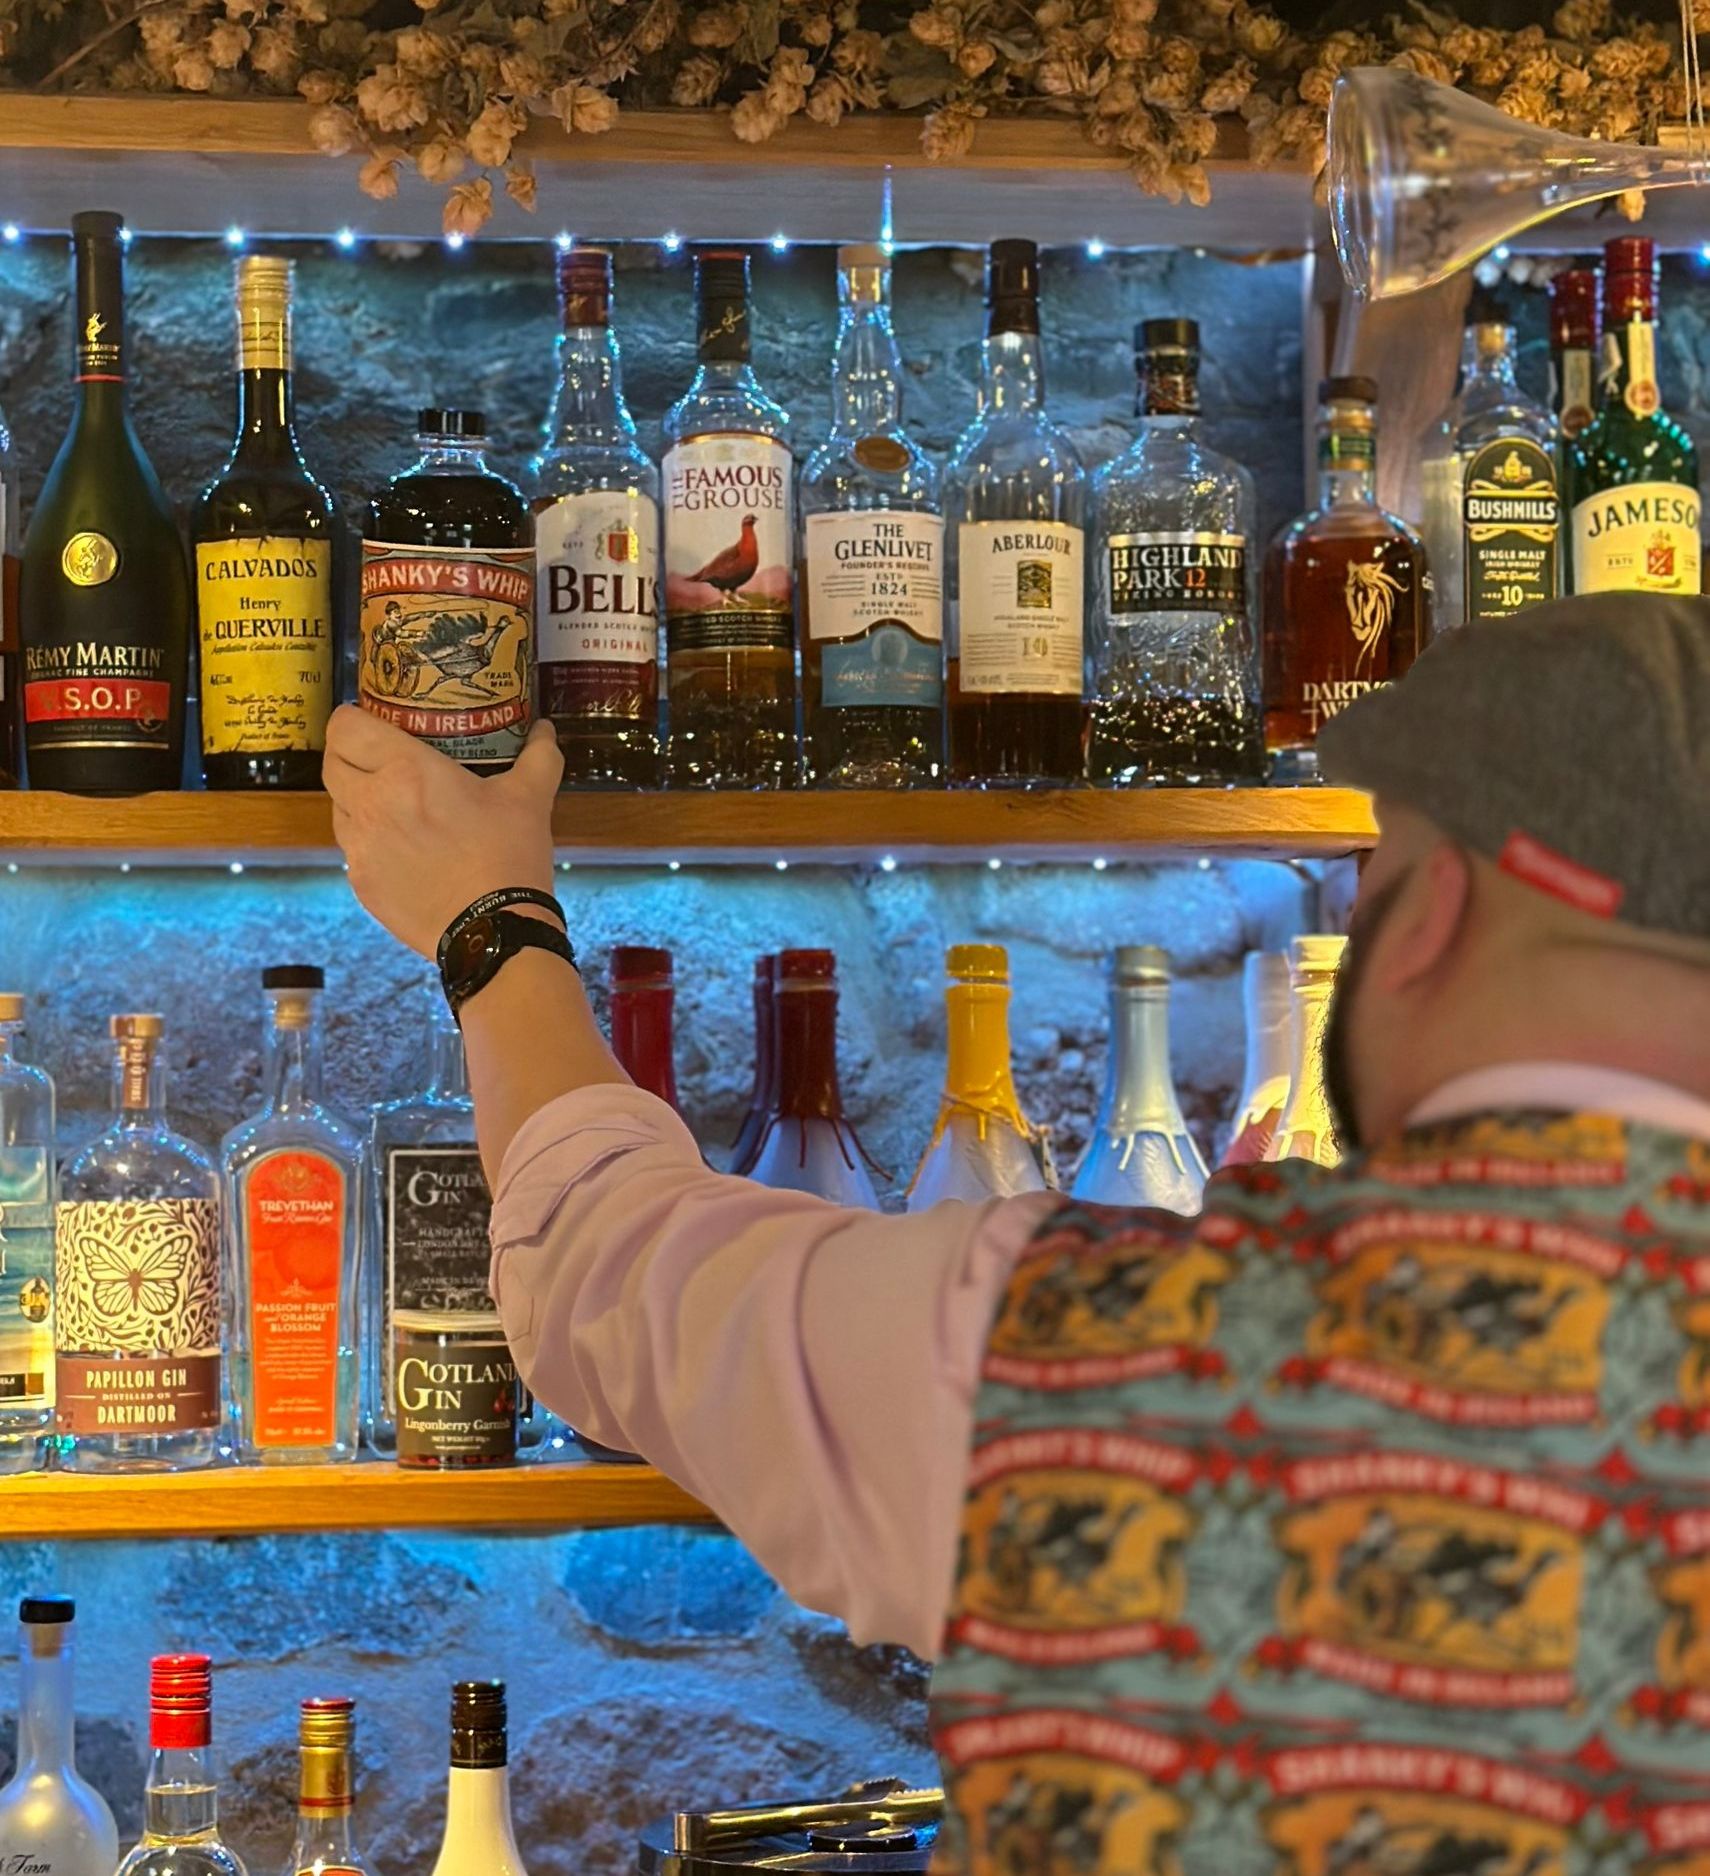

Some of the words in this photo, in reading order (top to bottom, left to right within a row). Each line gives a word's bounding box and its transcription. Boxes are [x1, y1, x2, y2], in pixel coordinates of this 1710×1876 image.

[685, 465, 783, 490] FAMOUS
[684, 487, 784, 511] GROUSE
[1468, 499, 1556, 520] BUSHMILLS
[1588, 498, 1697, 538] JAMESO
[873, 524, 904, 538] THE
[835, 540, 933, 561] GLENLIVET
[992, 534, 1071, 556] ABERLOUR
[1479, 550, 1516, 560] SINGLE
[1518, 550, 1546, 560] MALT
[841, 561, 893, 570] FOUNDER'S
[1113, 546, 1241, 569] HIGHLAND
[205, 558, 319, 581] CALVADOS
[1113, 568, 1182, 592] PARK
[1186, 567, 1206, 588] 12
[362, 564, 469, 594] SHANKY'S
[477, 568, 530, 599] WHIP
[871, 582, 908, 596] 1824
[240, 597, 281, 612] Henry
[1501, 585, 1524, 606] 10
[215, 618, 326, 640] QUERVILLE
[558, 622, 599, 630] BLENDED
[582, 638, 648, 652] ORIGINAL
[26, 644, 71, 670] RÉMY
[77, 642, 160, 668] MARTIN
[66, 668, 89, 676] FINE
[93, 668, 155, 677] CHAMPAGNE
[1304, 681, 1393, 701] DARTM
[364, 699, 401, 722] ADE
[408, 714, 427, 731] IN
[435, 706, 514, 732] IRELAND
[472, 894, 506, 918] BURNT
[259, 1200, 334, 1212] TREVETHAN
[256, 1303, 302, 1312] PASSION
[304, 1303, 337, 1312] FRUIT
[280, 1313, 326, 1322] ORANGE
[271, 1323, 321, 1333] BLOSSOM
[86, 1370, 155, 1388] PAPILLON
[162, 1368, 187, 1387] GIN
[102, 1393, 154, 1401] DISTILLED
[97, 1404, 176, 1424] DARTMOOR
[405, 1417, 471, 1432] Lingonberry
